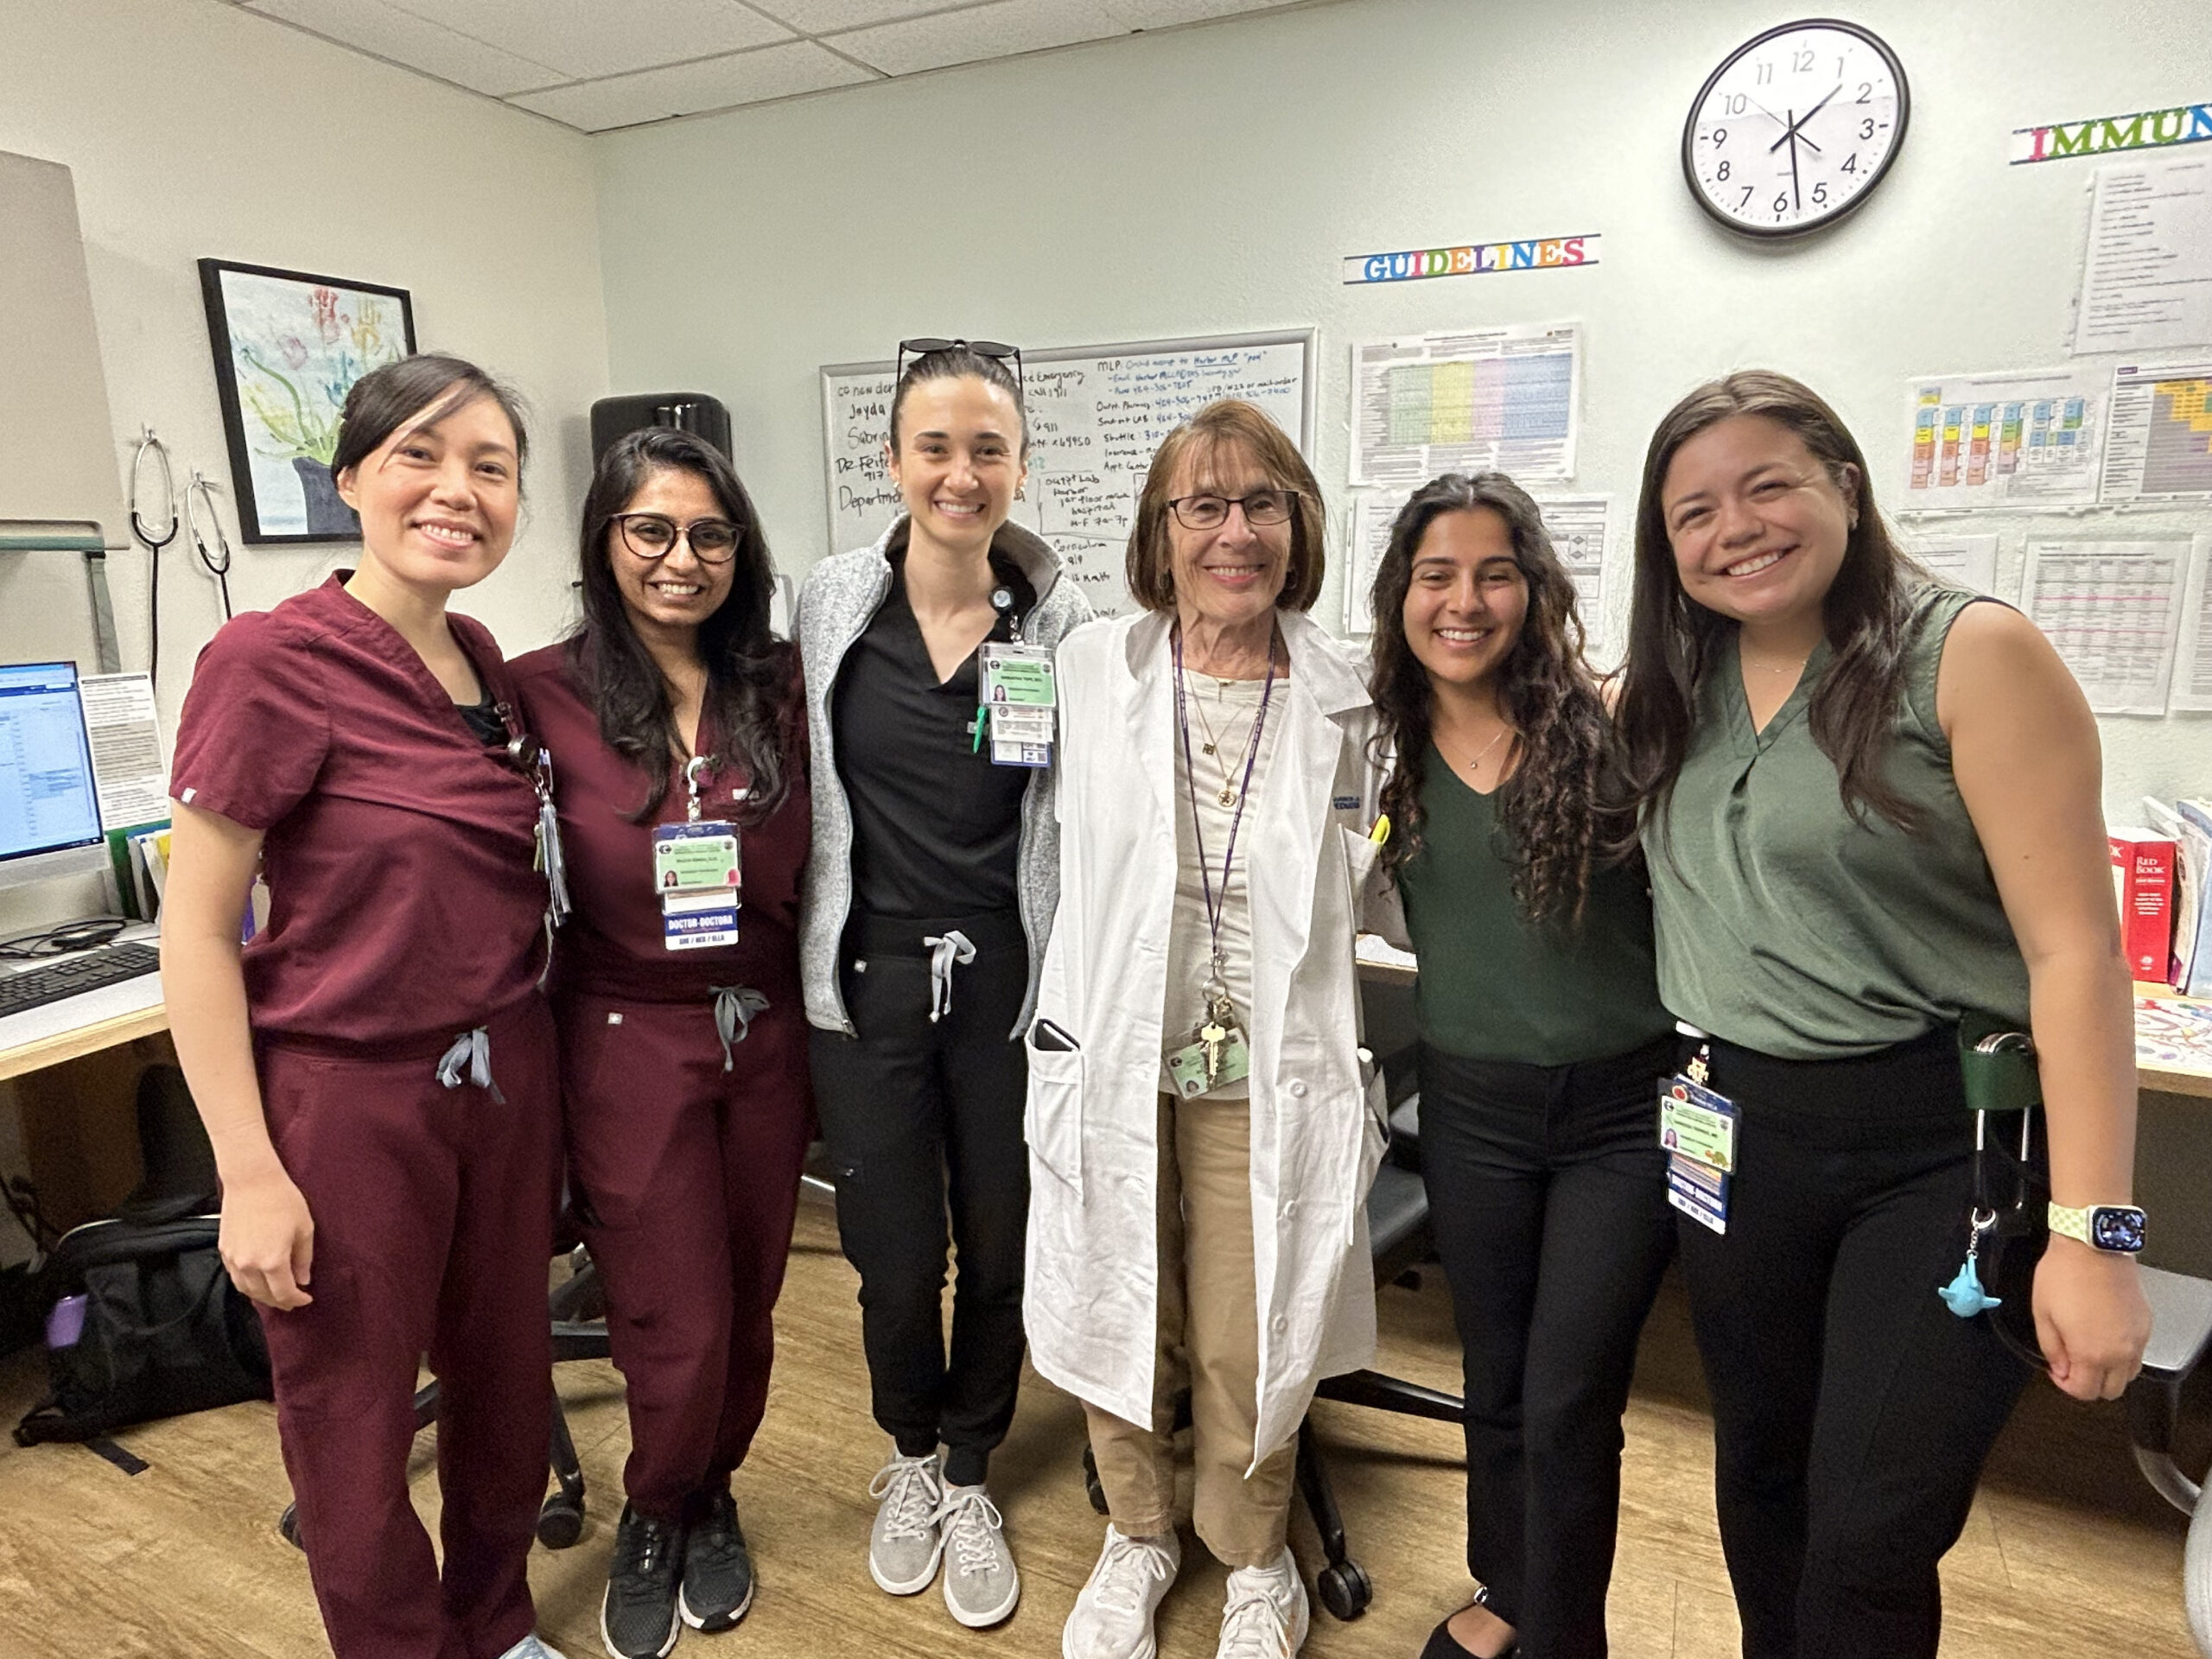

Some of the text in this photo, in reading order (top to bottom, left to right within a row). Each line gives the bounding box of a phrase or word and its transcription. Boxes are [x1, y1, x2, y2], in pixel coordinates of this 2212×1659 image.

[1792, 50, 1815, 73] 12
[1837, 56, 1844, 79] 1
[1757, 63, 1772, 85] 11
[1725, 92, 1747, 115] 10
[1855, 82, 1872, 105] 2
[1713, 128, 1727, 149] 9
[1859, 118, 1874, 140] 3
[1717, 161, 1731, 181] 8
[1840, 152, 1857, 175] 4
[1741, 186, 1754, 207] 7
[1773, 191, 1788, 213] 6
[1812, 182, 1827, 204] 5
[1364, 238, 1585, 282] GUIDELINES
[849, 403, 886, 421] Jayda
[2136, 855, 2158, 866] RED
[2136, 864, 2165, 874] BOOK
